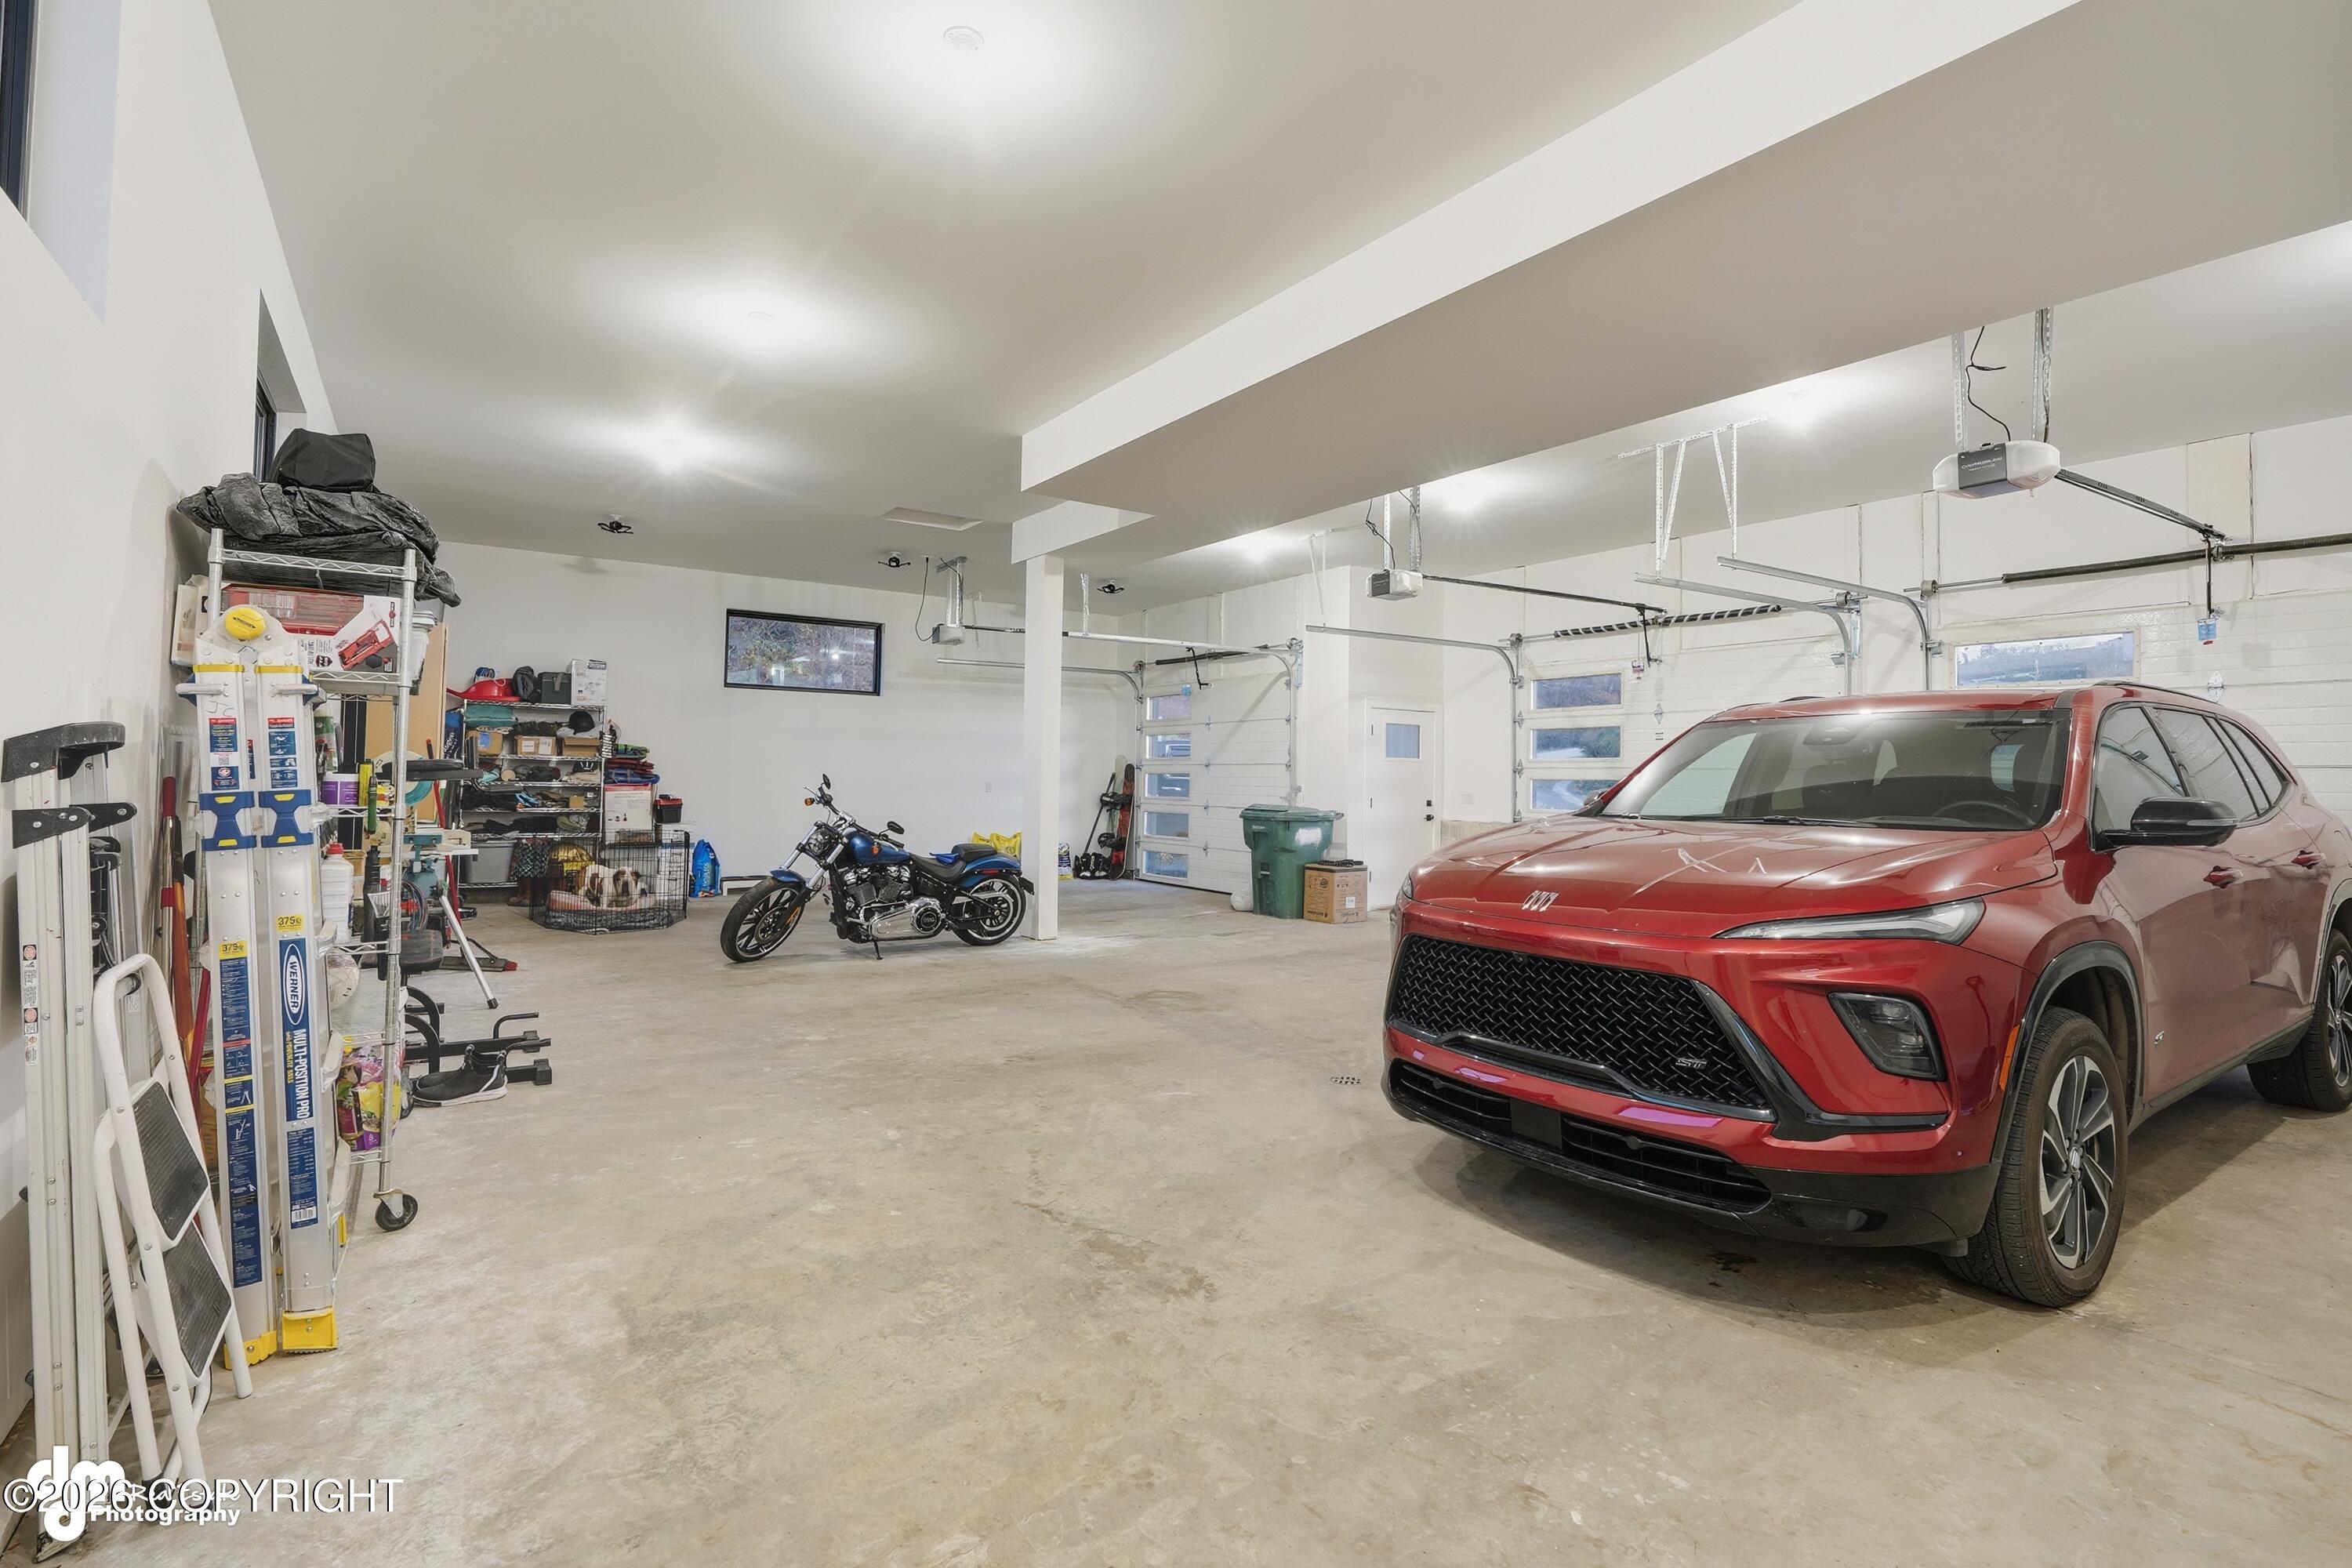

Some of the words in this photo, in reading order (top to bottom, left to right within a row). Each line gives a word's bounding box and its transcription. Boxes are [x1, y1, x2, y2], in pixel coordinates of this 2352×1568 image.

[289, 960, 299, 1010] WERNER
[293, 1029, 309, 1099] MULTI-POSITION
[296, 1100, 310, 1119] PRO
